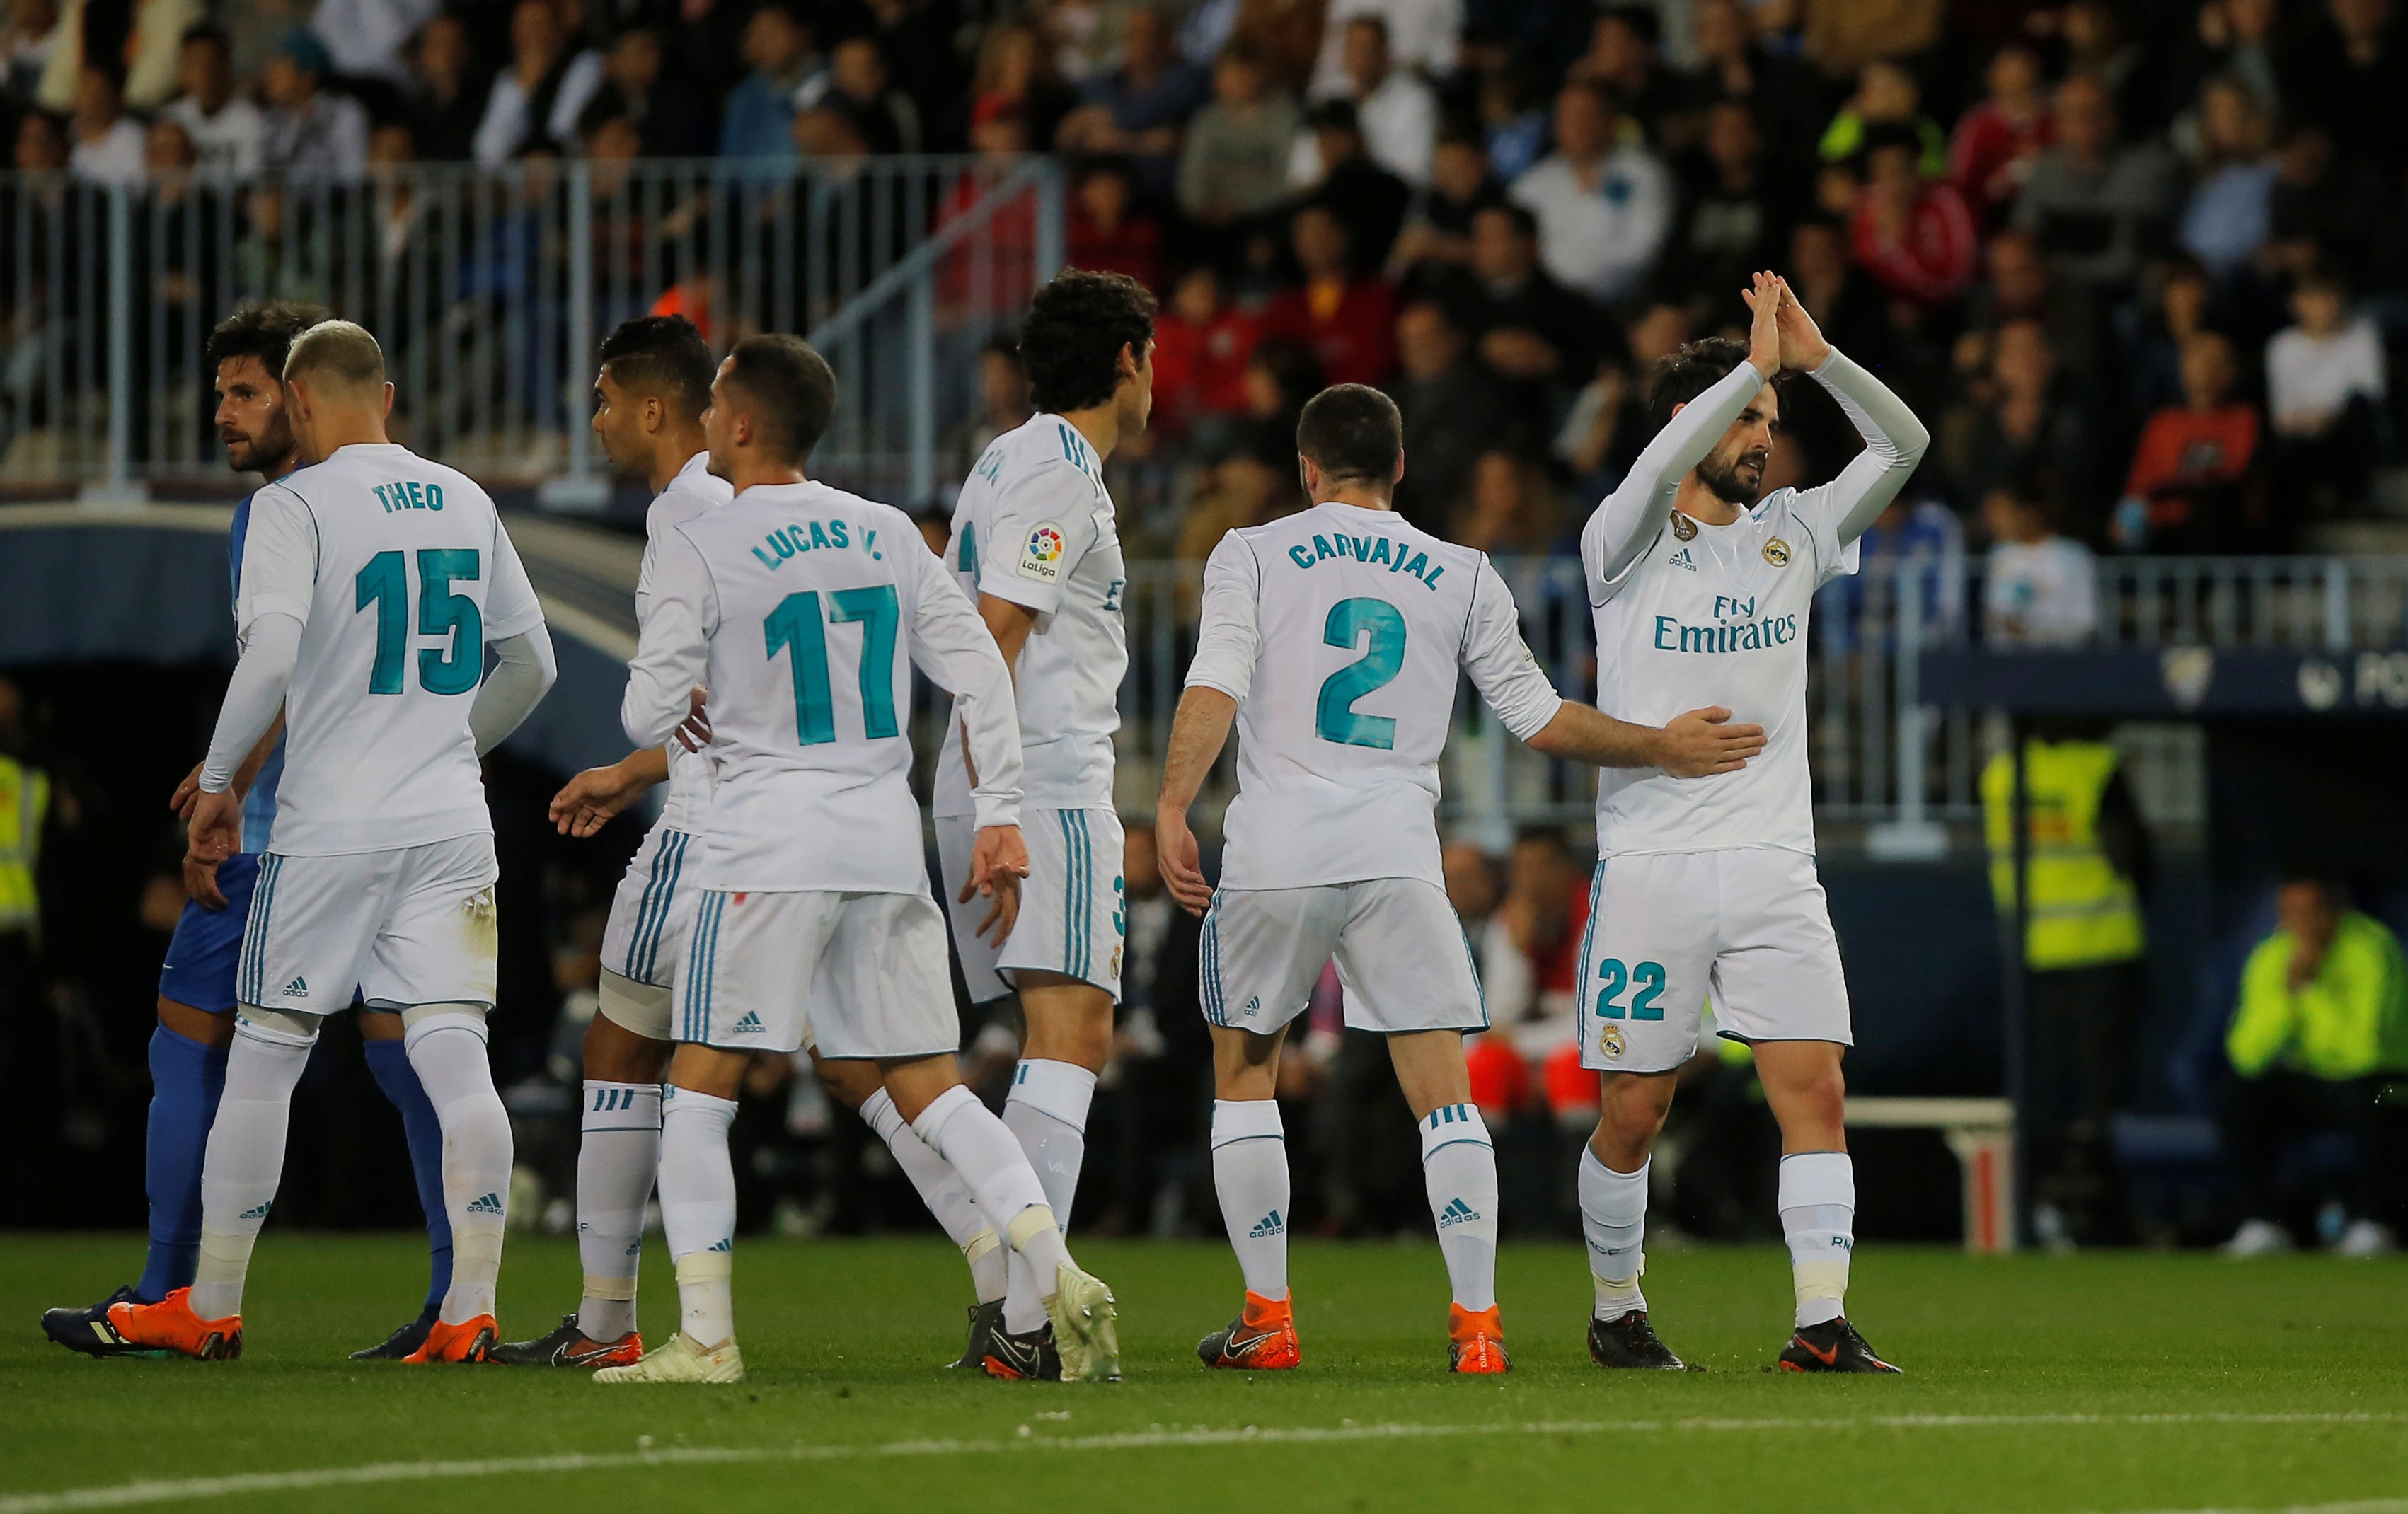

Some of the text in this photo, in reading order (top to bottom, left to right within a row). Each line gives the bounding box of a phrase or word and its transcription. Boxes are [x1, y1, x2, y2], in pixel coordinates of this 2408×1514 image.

[372, 482, 444, 514] THEO
[751, 519, 882, 571] LUCAS V.
[1289, 533, 1445, 591] CARVAJAL
[1669, 557, 1698, 572] adidas
[1022, 560, 1055, 576] LaLiga
[356, 549, 483, 695] 15
[1713, 596, 1755, 618] Fly
[1654, 613, 1796, 653] Emirates
[764, 584, 899, 746] 17
[1315, 596, 1407, 750] 2
[1596, 958, 1666, 1021] 22
[1249, 1225, 1285, 1238] adidas
[1440, 1212, 1480, 1229] adidas
